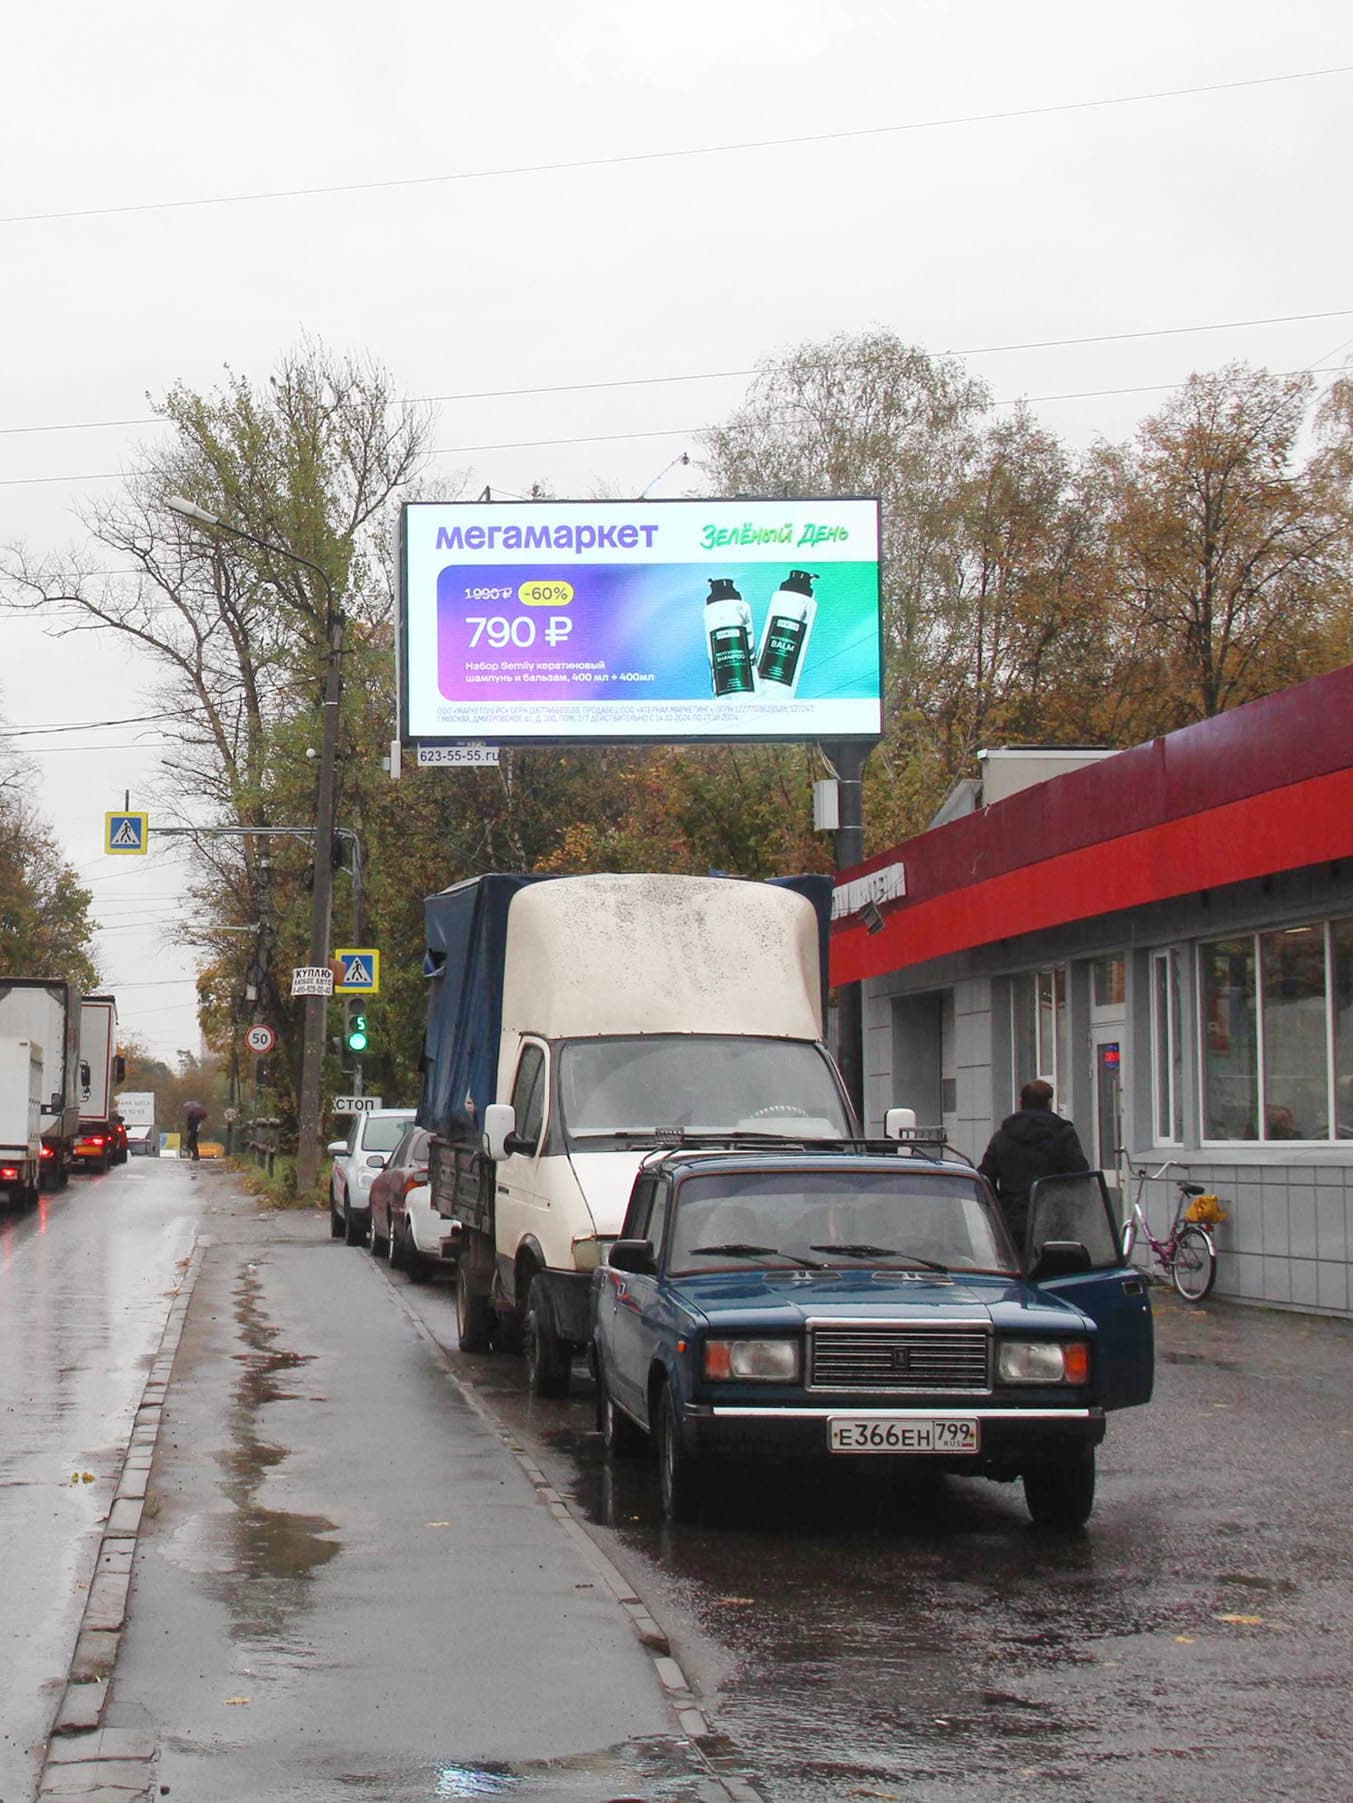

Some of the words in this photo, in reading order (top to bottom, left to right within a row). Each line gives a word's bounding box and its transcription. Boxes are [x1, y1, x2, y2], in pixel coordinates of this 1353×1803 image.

[435, 524, 659, 554] мегамаркет
[524, 586, 568, 600] -60%
[465, 616, 536, 648] 790
[545, 616, 573, 647] ₽
[770, 639, 795, 652] BALM
[465, 661, 499, 671] Набор
[536, 660, 605, 670] кератиновый
[465, 673, 512, 684] шампунь
[514, 674, 521, 682] и
[523, 672, 570, 684] бальзам,
[572, 672, 592, 682] 400
[593, 673, 609, 682] мл
[420, 750, 499, 761] 623-55-55.ru
[296, 968, 332, 979] КУПЛЮ
[357, 1017, 365, 1030] 5
[252, 1033, 268, 1045] 50
[336, 1099, 374, 1111] СТОП
[839, 1424, 930, 1447] Е366ЕН
[935, 1423, 970, 1441] 799
